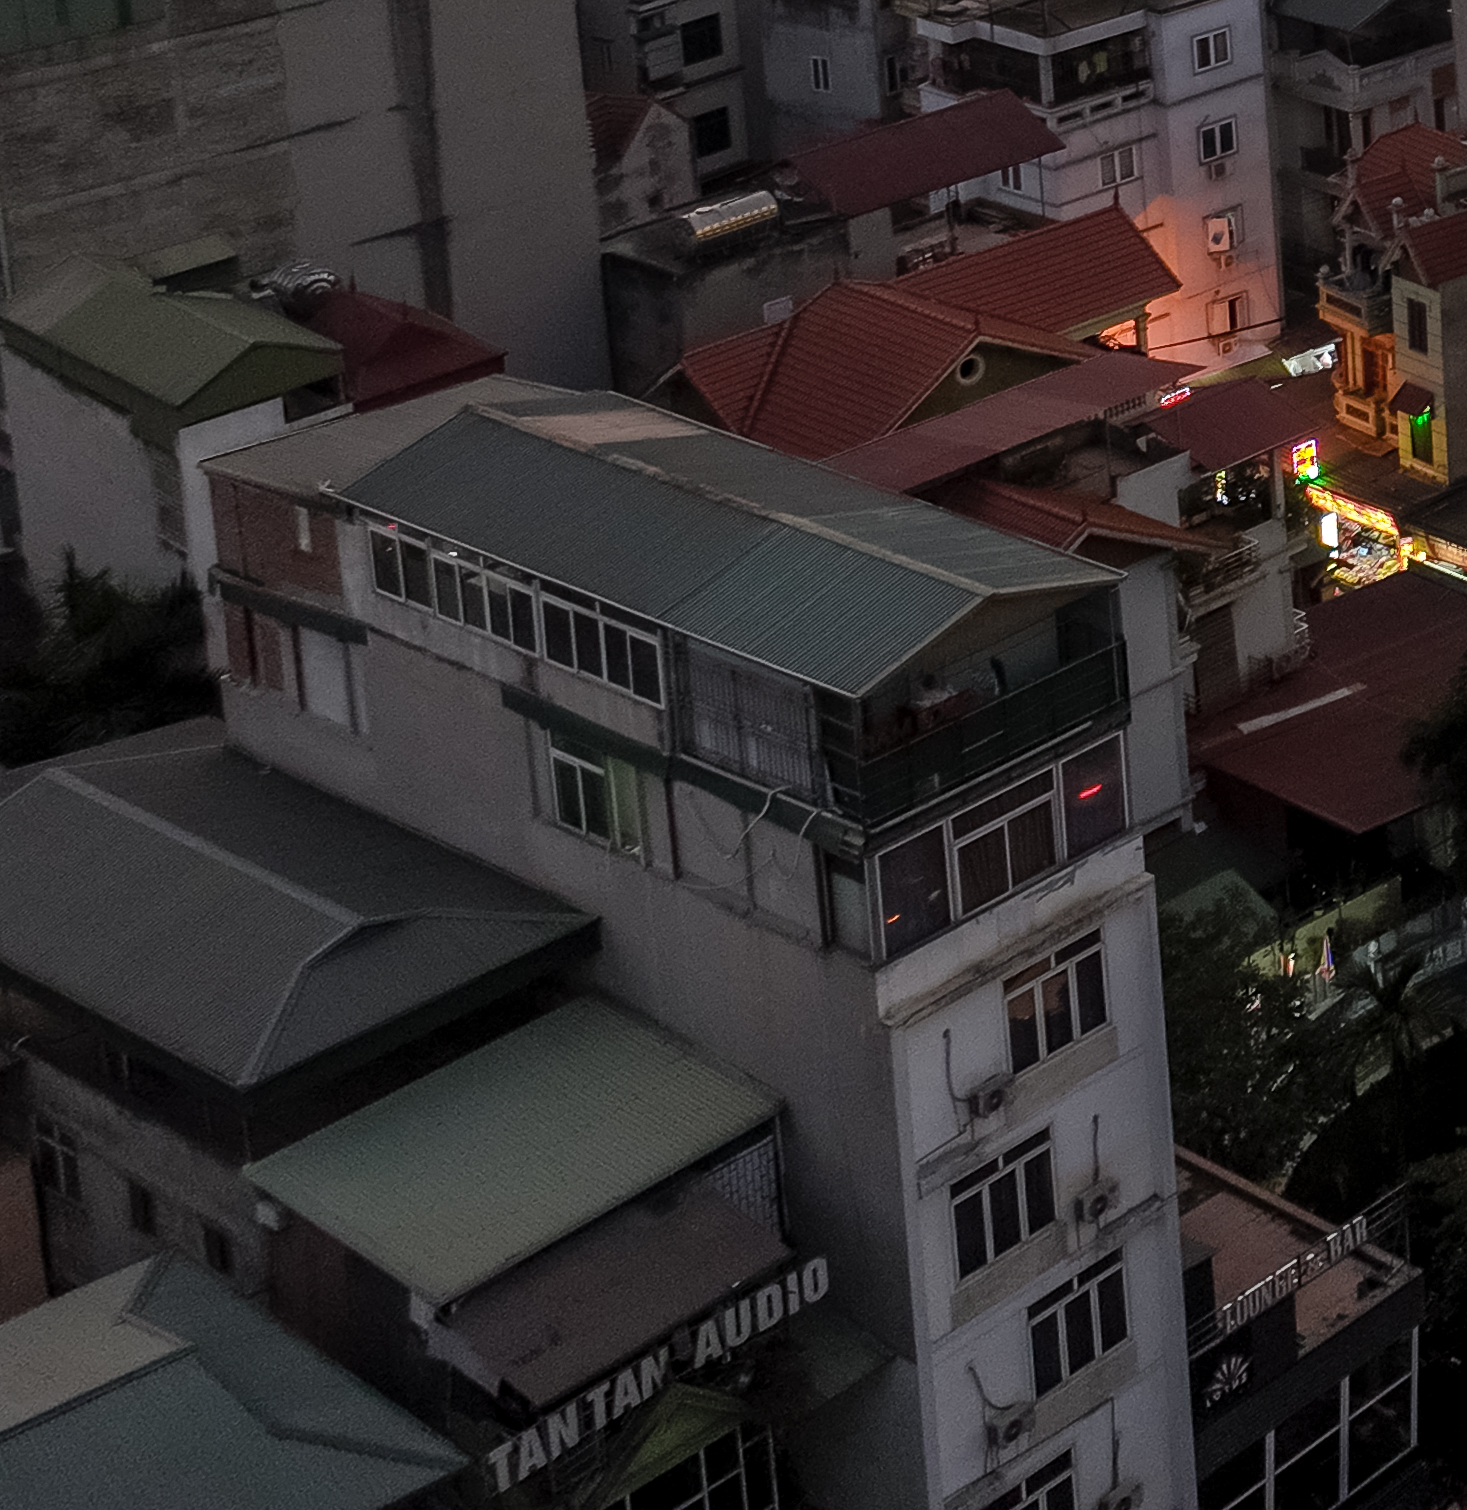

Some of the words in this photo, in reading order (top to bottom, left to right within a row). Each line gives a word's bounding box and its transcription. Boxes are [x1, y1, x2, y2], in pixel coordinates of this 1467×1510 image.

[692, 1255, 831, 1371] AUDIO
[1222, 1258, 1300, 1335] LOUNGE
[1326, 1214, 1369, 1265] BAR
